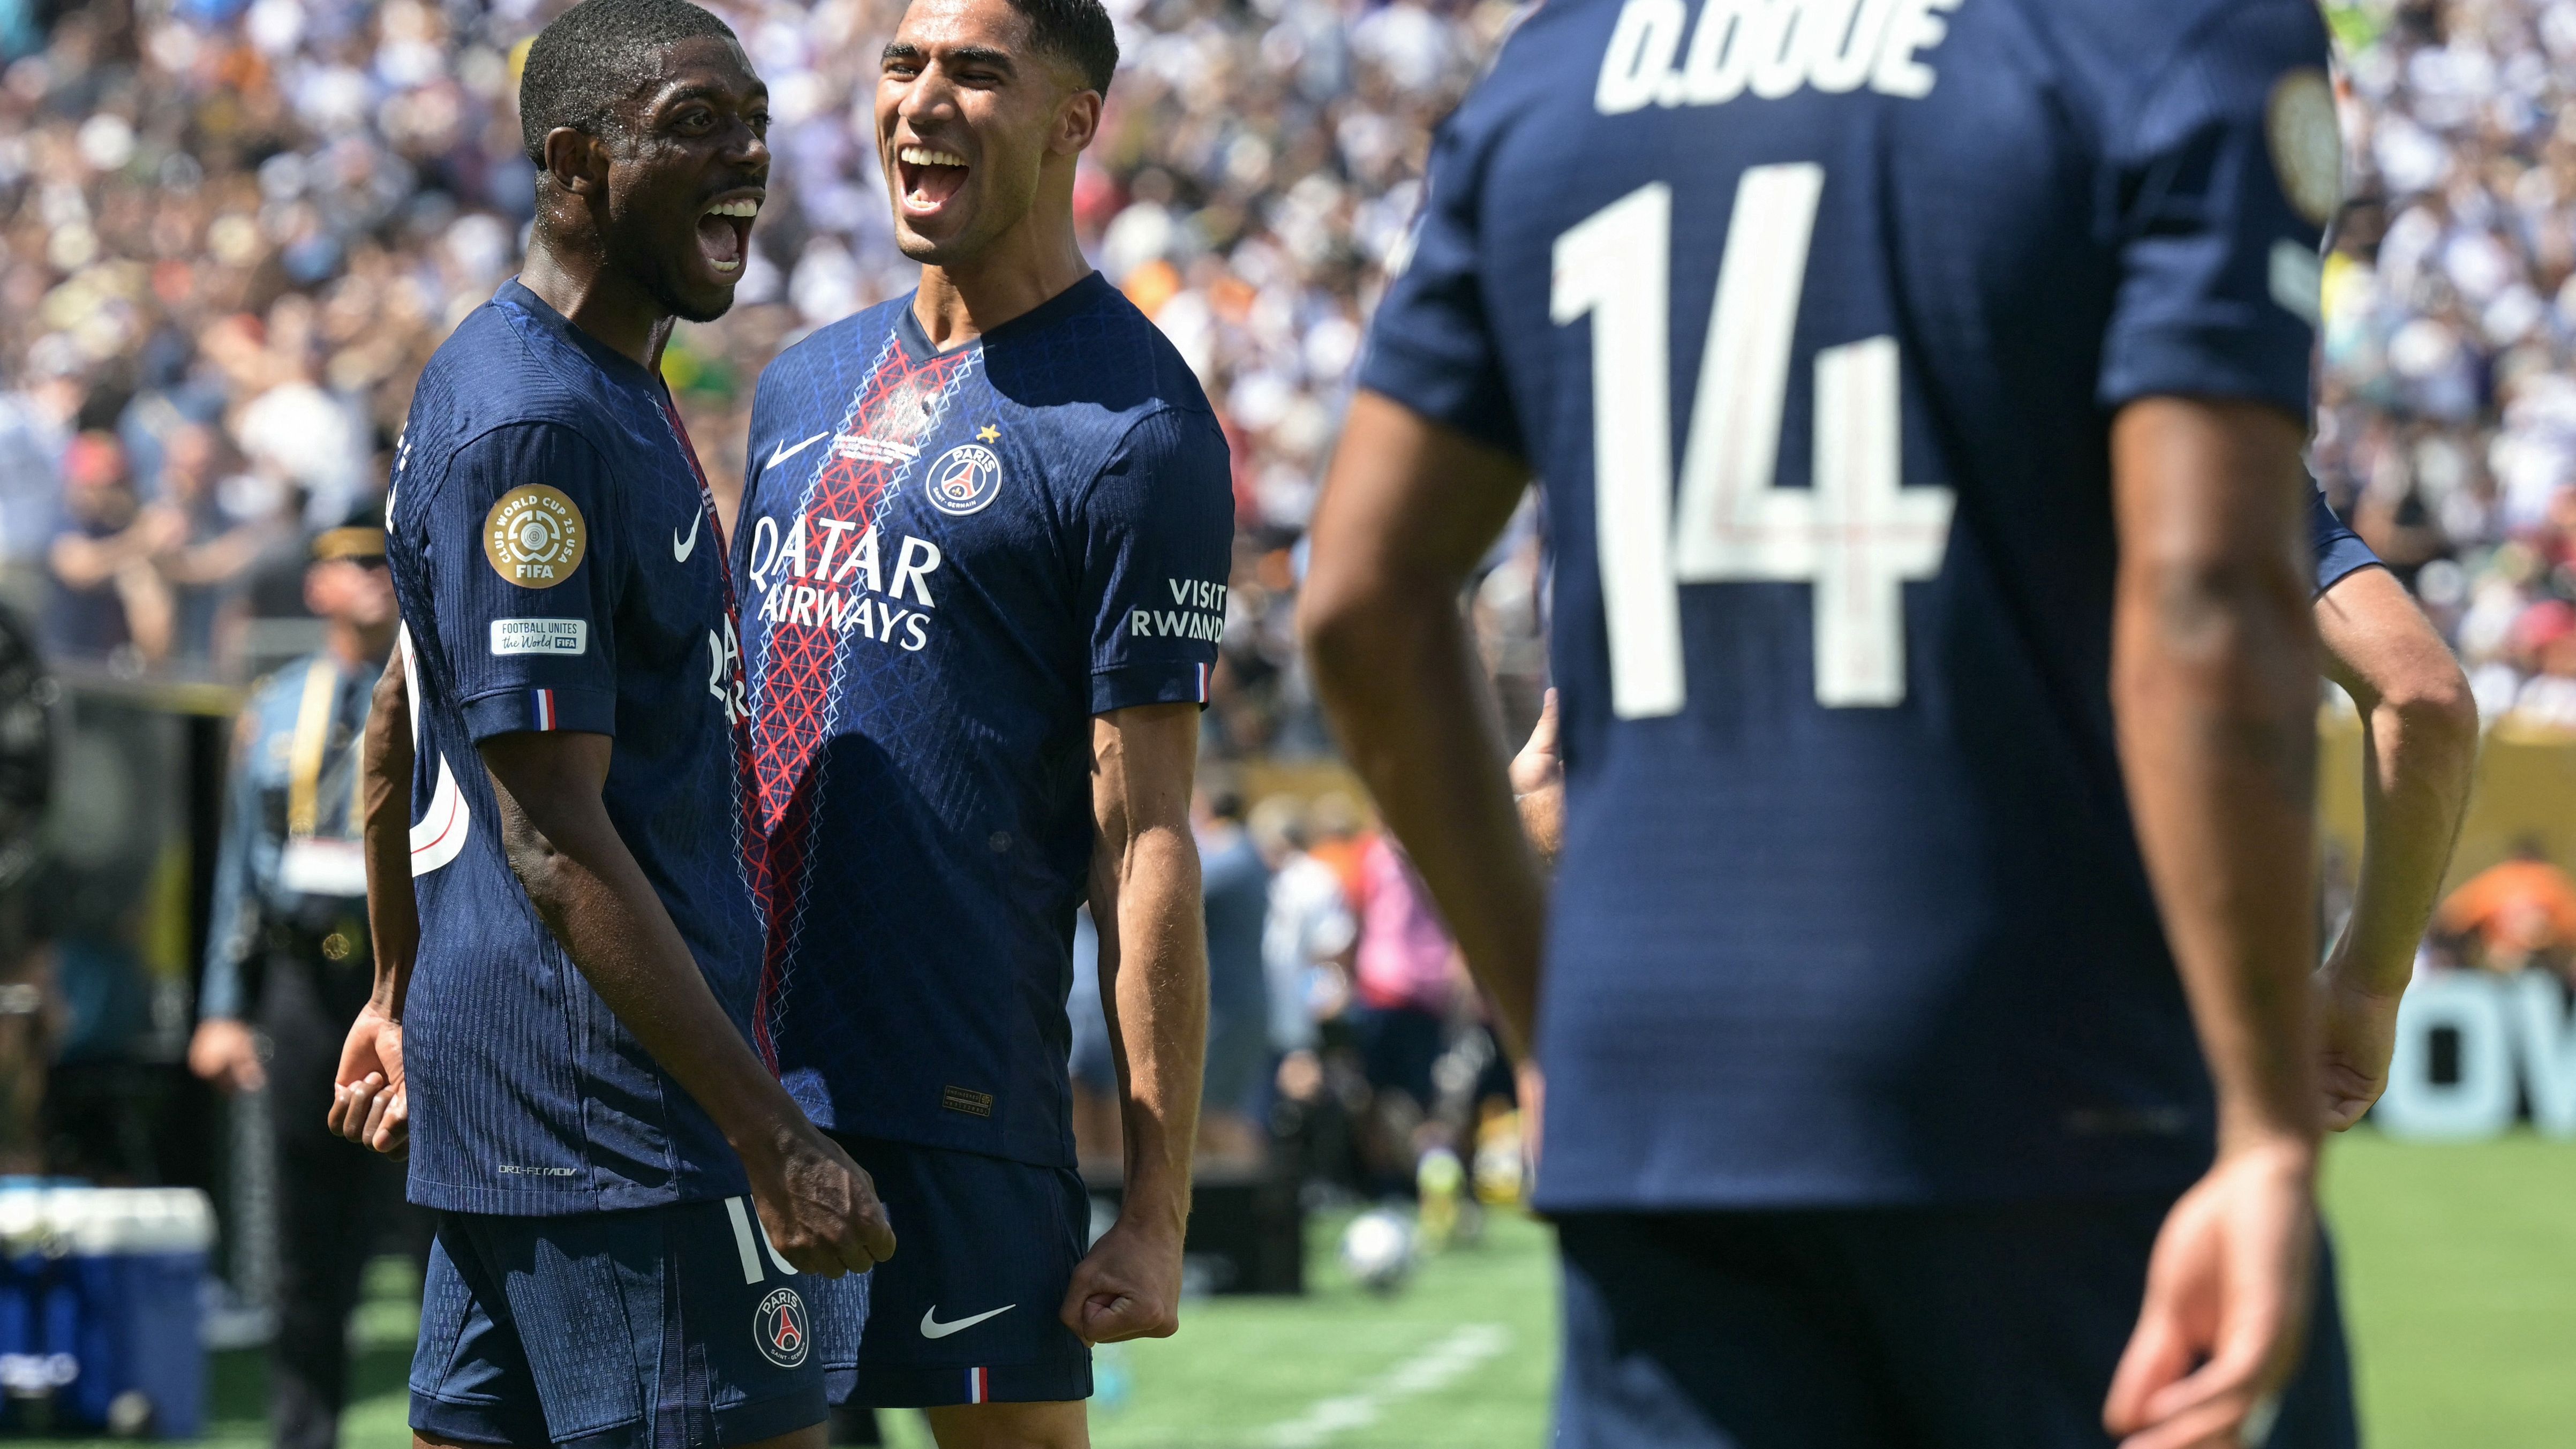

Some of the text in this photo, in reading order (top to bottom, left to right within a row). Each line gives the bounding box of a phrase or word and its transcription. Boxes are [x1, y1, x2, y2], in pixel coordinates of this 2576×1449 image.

[1550, 161, 1956, 721] 14
[952, 448, 996, 472] PARIS
[494, 495, 575, 563] CLUB WORLD CUP 25 USA
[516, 564, 553, 578] FIFA
[749, 514, 941, 608] QATAR
[1169, 578, 1226, 612] VISIT
[502, 622, 577, 634] FOOTBALL UNITES
[757, 583, 930, 651] AIRWAYS
[1132, 610, 1224, 645] RWAND
[502, 634, 576, 649] the World FIFA
[762, 1292, 797, 1315] PARIS
